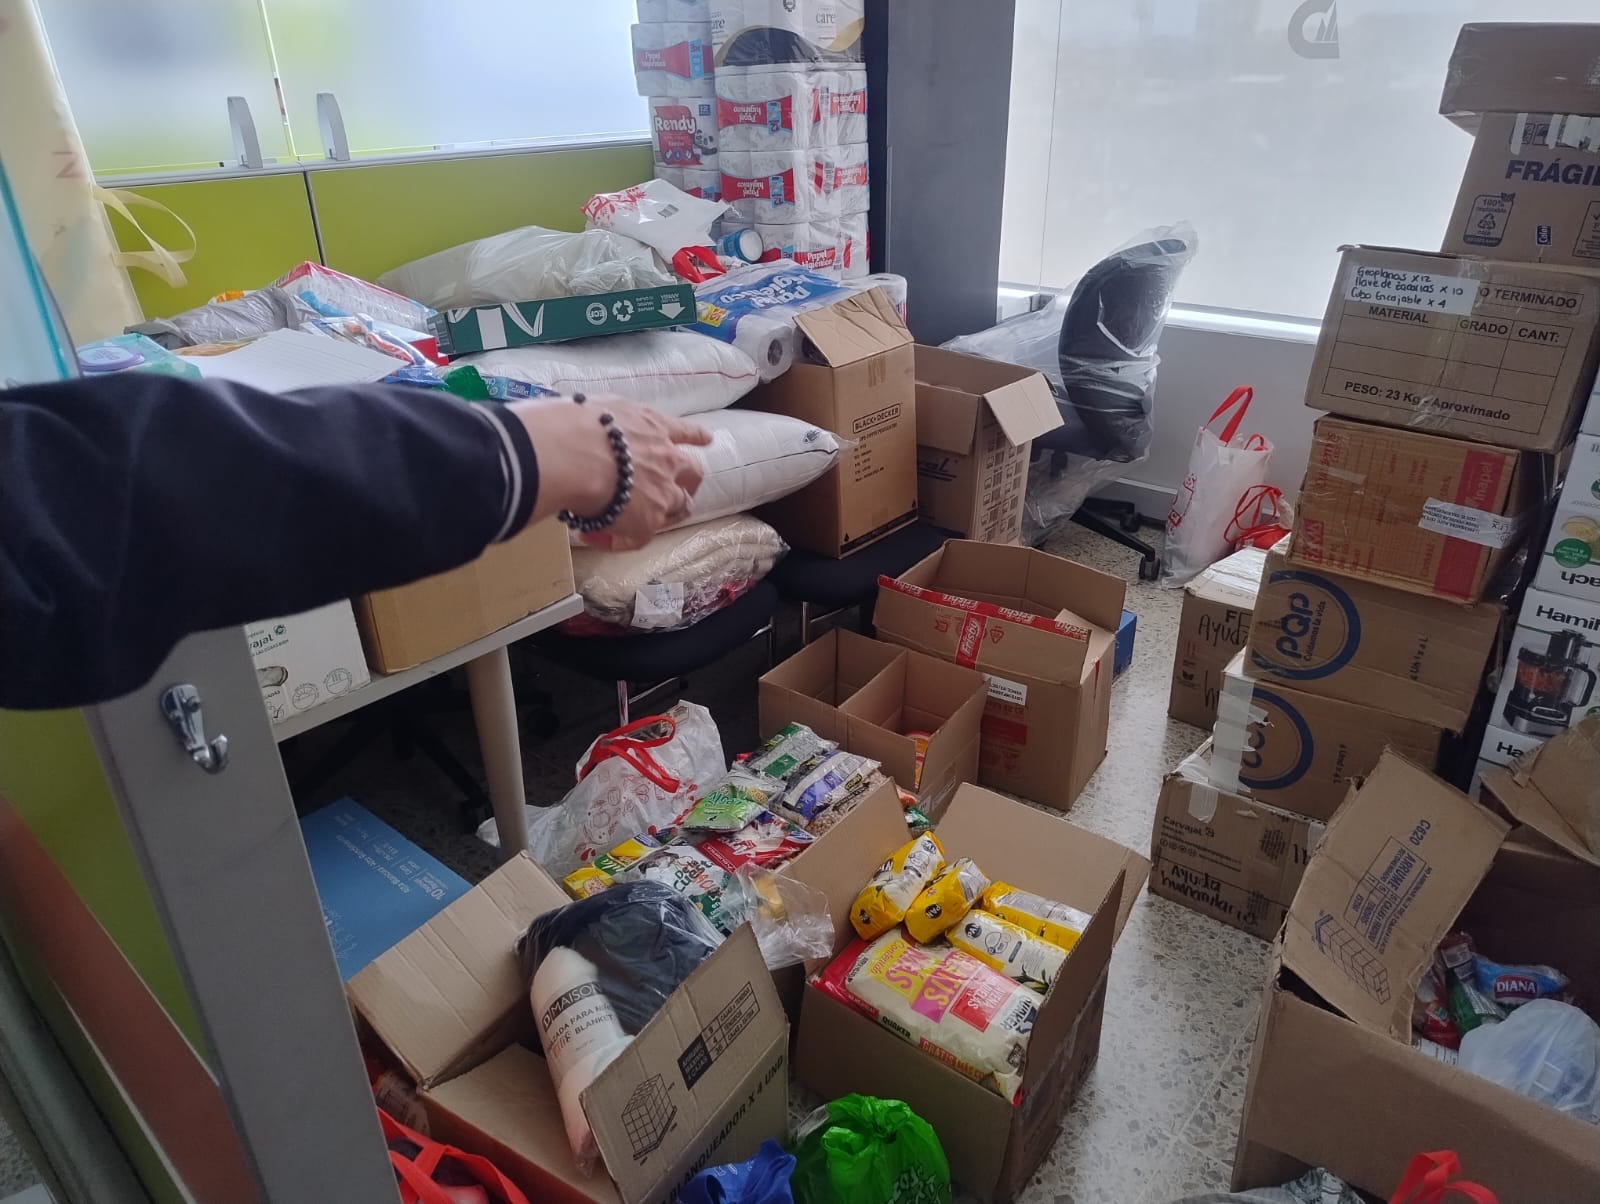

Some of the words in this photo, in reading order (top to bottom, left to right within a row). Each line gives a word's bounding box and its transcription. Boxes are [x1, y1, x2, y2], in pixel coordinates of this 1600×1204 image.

[654, 115, 697, 134] Rendy
[807, 249, 827, 262] Papel
[1494, 288, 1577, 310] TERMINADO
[1368, 305, 1429, 324] MATERIAL
[1459, 318, 1508, 336] GRADO
[1517, 327, 1561, 343] CANT:
[1344, 380, 1382, 398] PESO:
[1385, 389, 1400, 401] 23
[1403, 391, 1420, 406] Kg
[1430, 398, 1511, 422] Aproximado
[961, 617, 980, 657] Frisby
[1163, 816, 1202, 837] Carvajal
[1409, 819, 1431, 847] C620
[1386, 853, 1416, 892] ARRUME
[925, 904, 942, 918] PAN
[1496, 980, 1535, 994] DIANA
[550, 981, 603, 1020] MAISON
